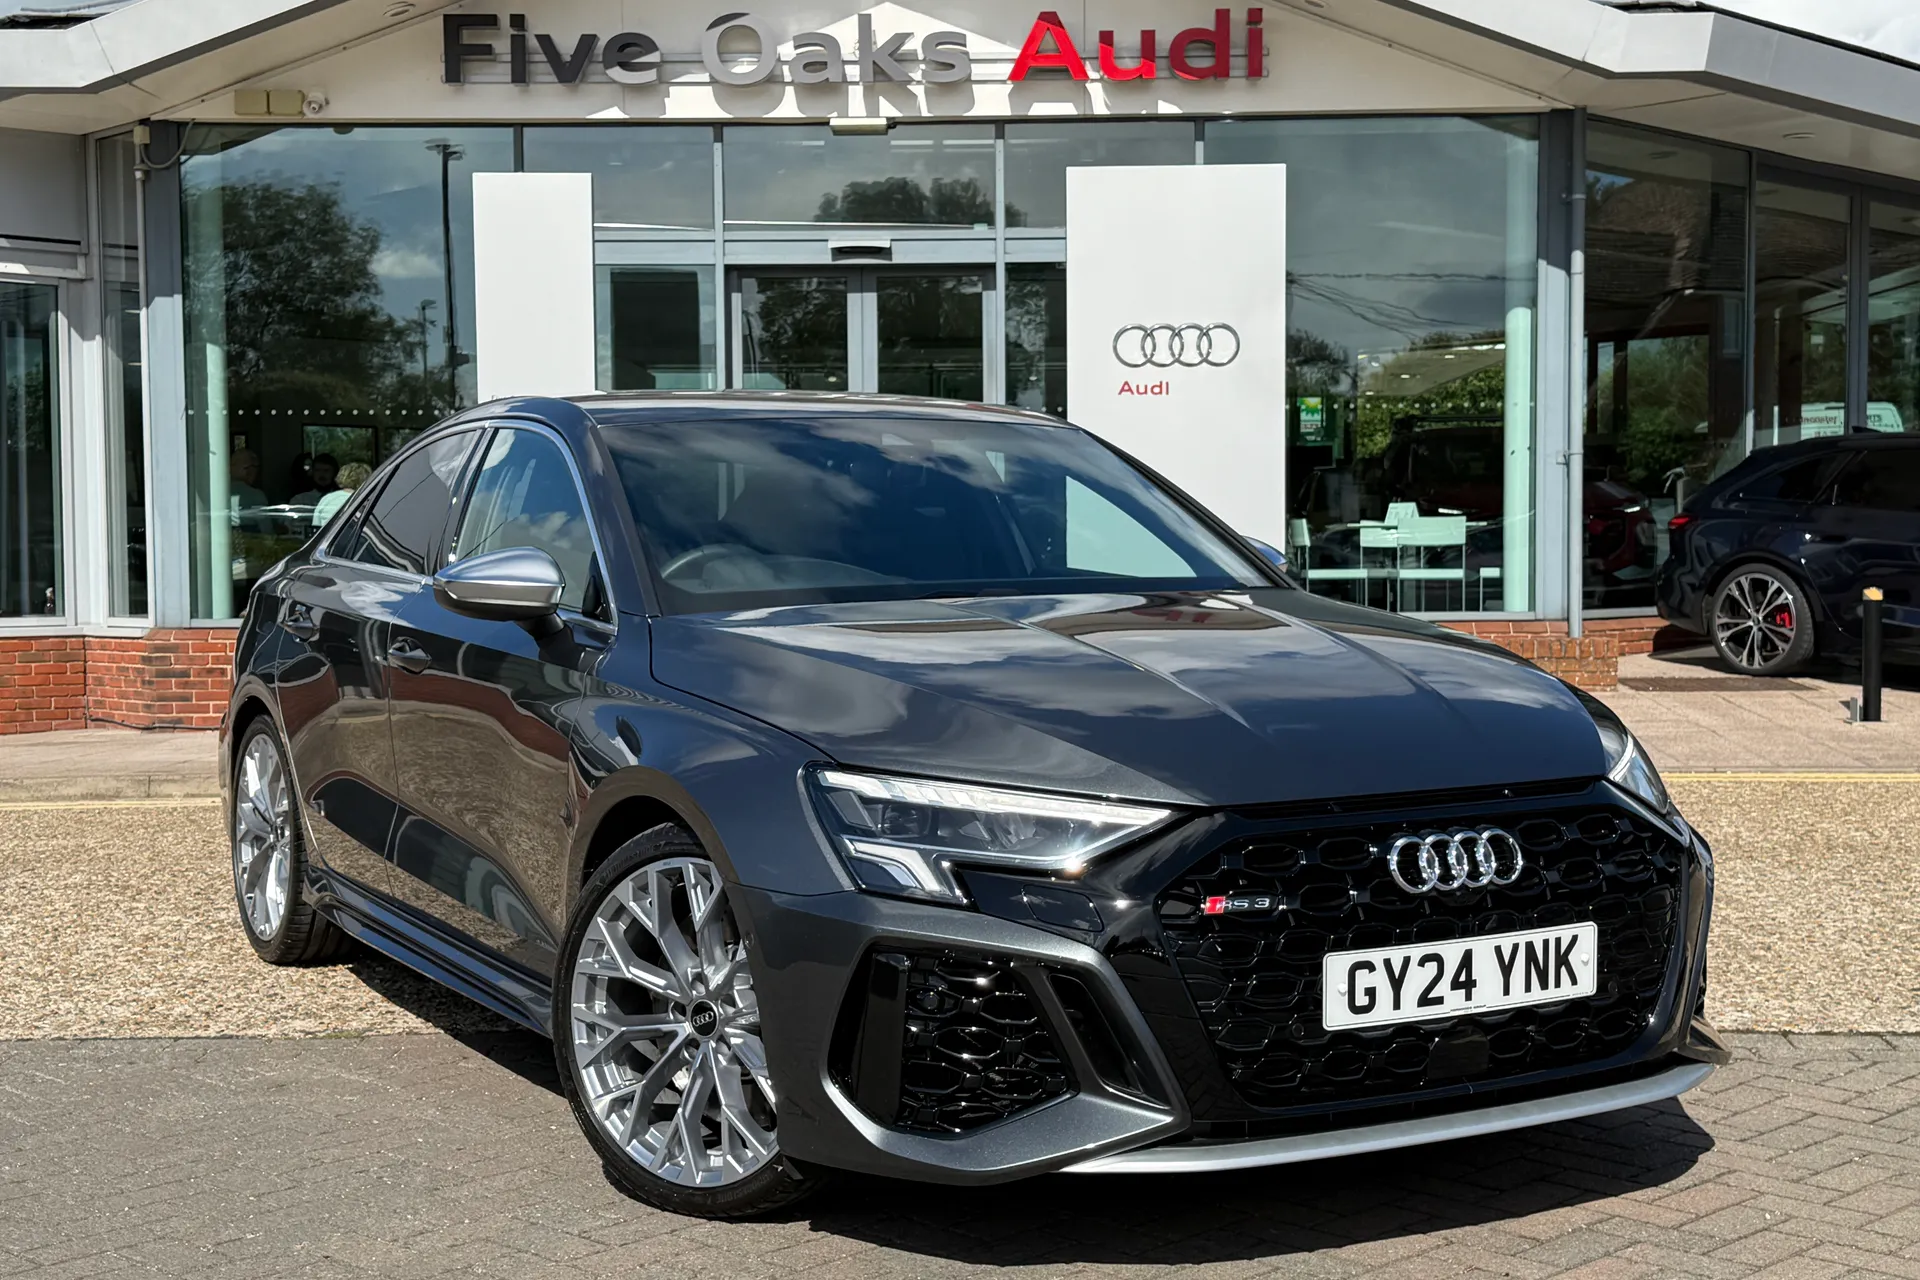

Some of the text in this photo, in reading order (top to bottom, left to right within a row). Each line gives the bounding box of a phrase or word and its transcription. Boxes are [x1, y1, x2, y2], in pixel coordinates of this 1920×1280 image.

[442, 8, 1264, 85] Five Oaks Audi
[1117, 380, 1169, 396] Audi
[1254, 897, 1270, 908] 3
[1347, 934, 1579, 1016] GY24 YNK
